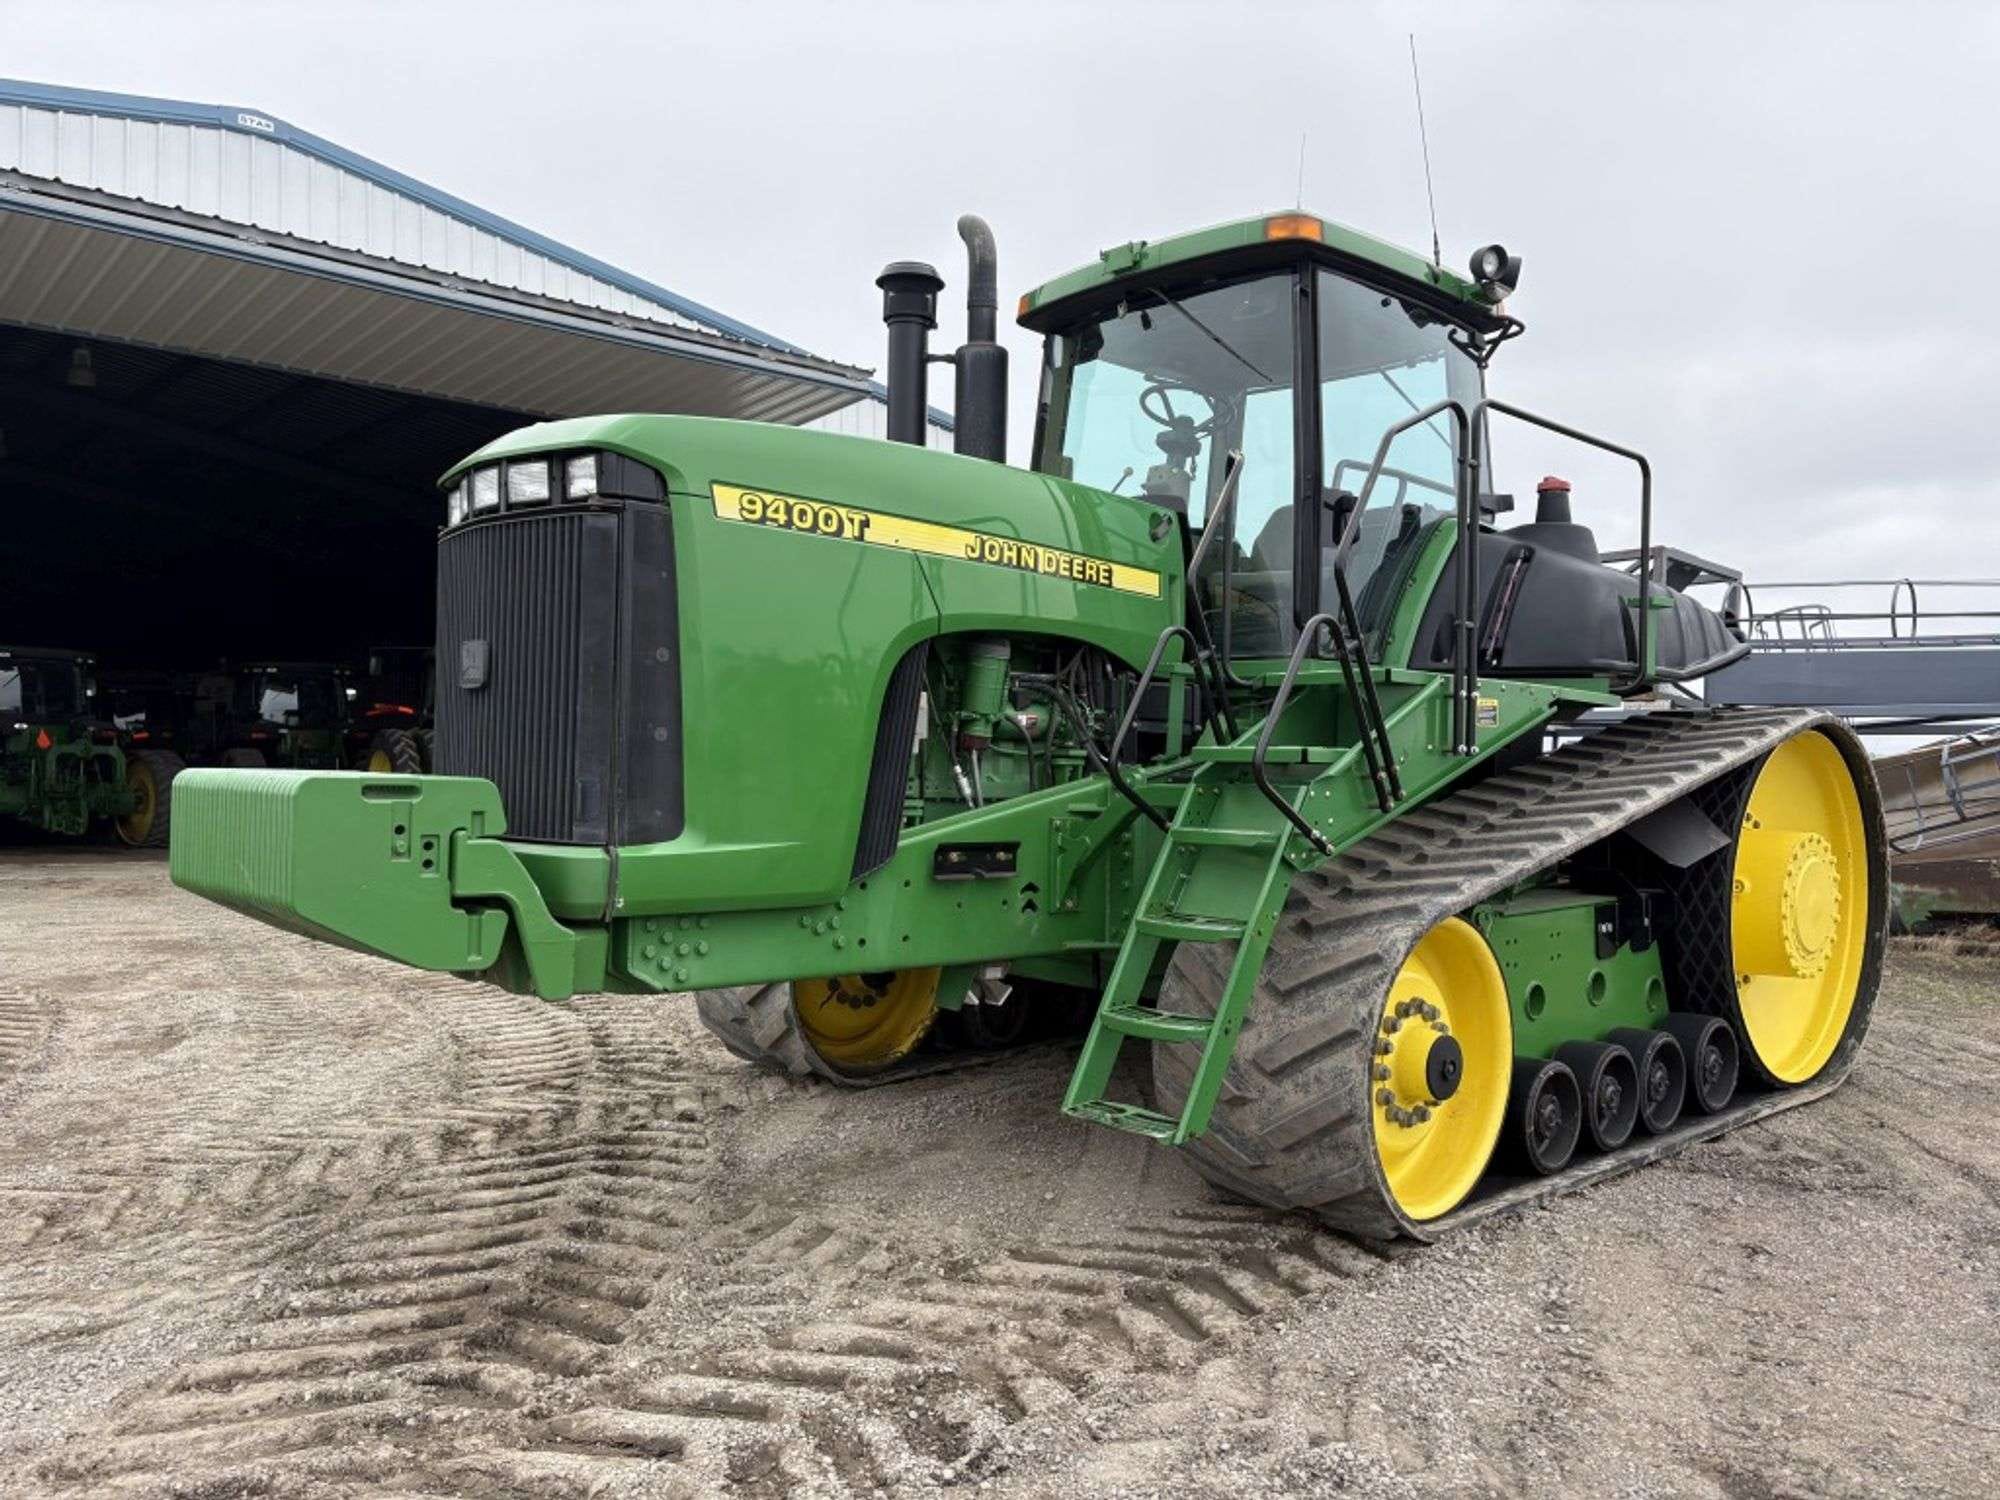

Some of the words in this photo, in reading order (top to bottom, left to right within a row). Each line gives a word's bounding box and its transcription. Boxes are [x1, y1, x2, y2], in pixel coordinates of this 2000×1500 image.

[739, 492, 870, 541] 9400T
[965, 535, 1038, 572] JOHN
[1043, 550, 1113, 587] DEERE
